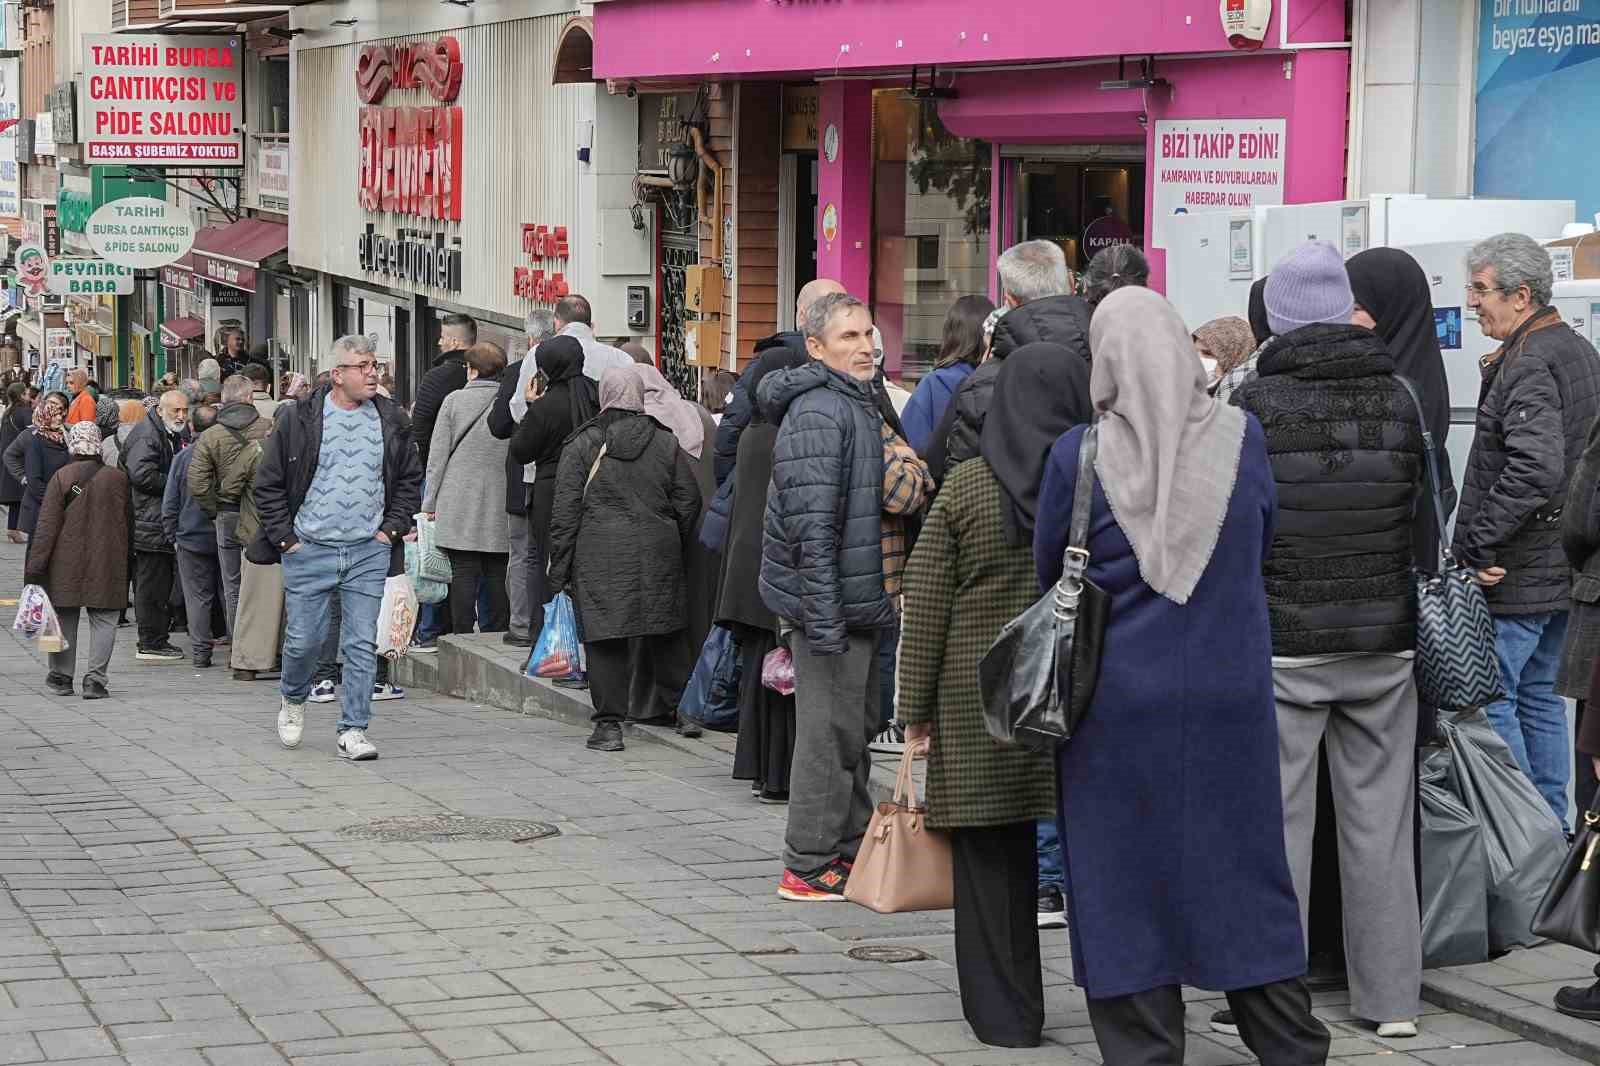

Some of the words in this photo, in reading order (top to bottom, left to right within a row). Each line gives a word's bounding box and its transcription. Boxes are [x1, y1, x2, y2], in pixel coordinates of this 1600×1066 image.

[1493, 24, 1536, 55] beyaz
[1538, 26, 1573, 53] eşya
[91, 43, 158, 66] TARİHİ
[165, 47, 234, 68] BURSA
[90, 76, 206, 103] CANTIKÇISI
[212, 81, 236, 102] ve
[96, 106, 143, 135] PİDE
[150, 112, 231, 136] SALONU
[1161, 128, 1189, 158] BİZİ
[1193, 128, 1234, 158] TAKİP
[1239, 127, 1279, 159] EDİN!
[92, 144, 132, 160] BAŞKA
[135, 143, 189, 160] ŞUBEMİZ
[191, 145, 236, 158] YOKTUR
[1161, 171, 1202, 185] KAMPANYA
[1204, 172, 1214, 185] VE
[1215, 171, 1278, 186] DUYURULARDAN
[1185, 191, 1225, 205] HABERDAR
[1227, 192, 1251, 206] OLUN!
[115, 205, 164, 217] TARİHİ
[93, 224, 127, 234] BURSA
[139, 242, 179, 253] SALONU
[70, 280, 116, 293] BABA
